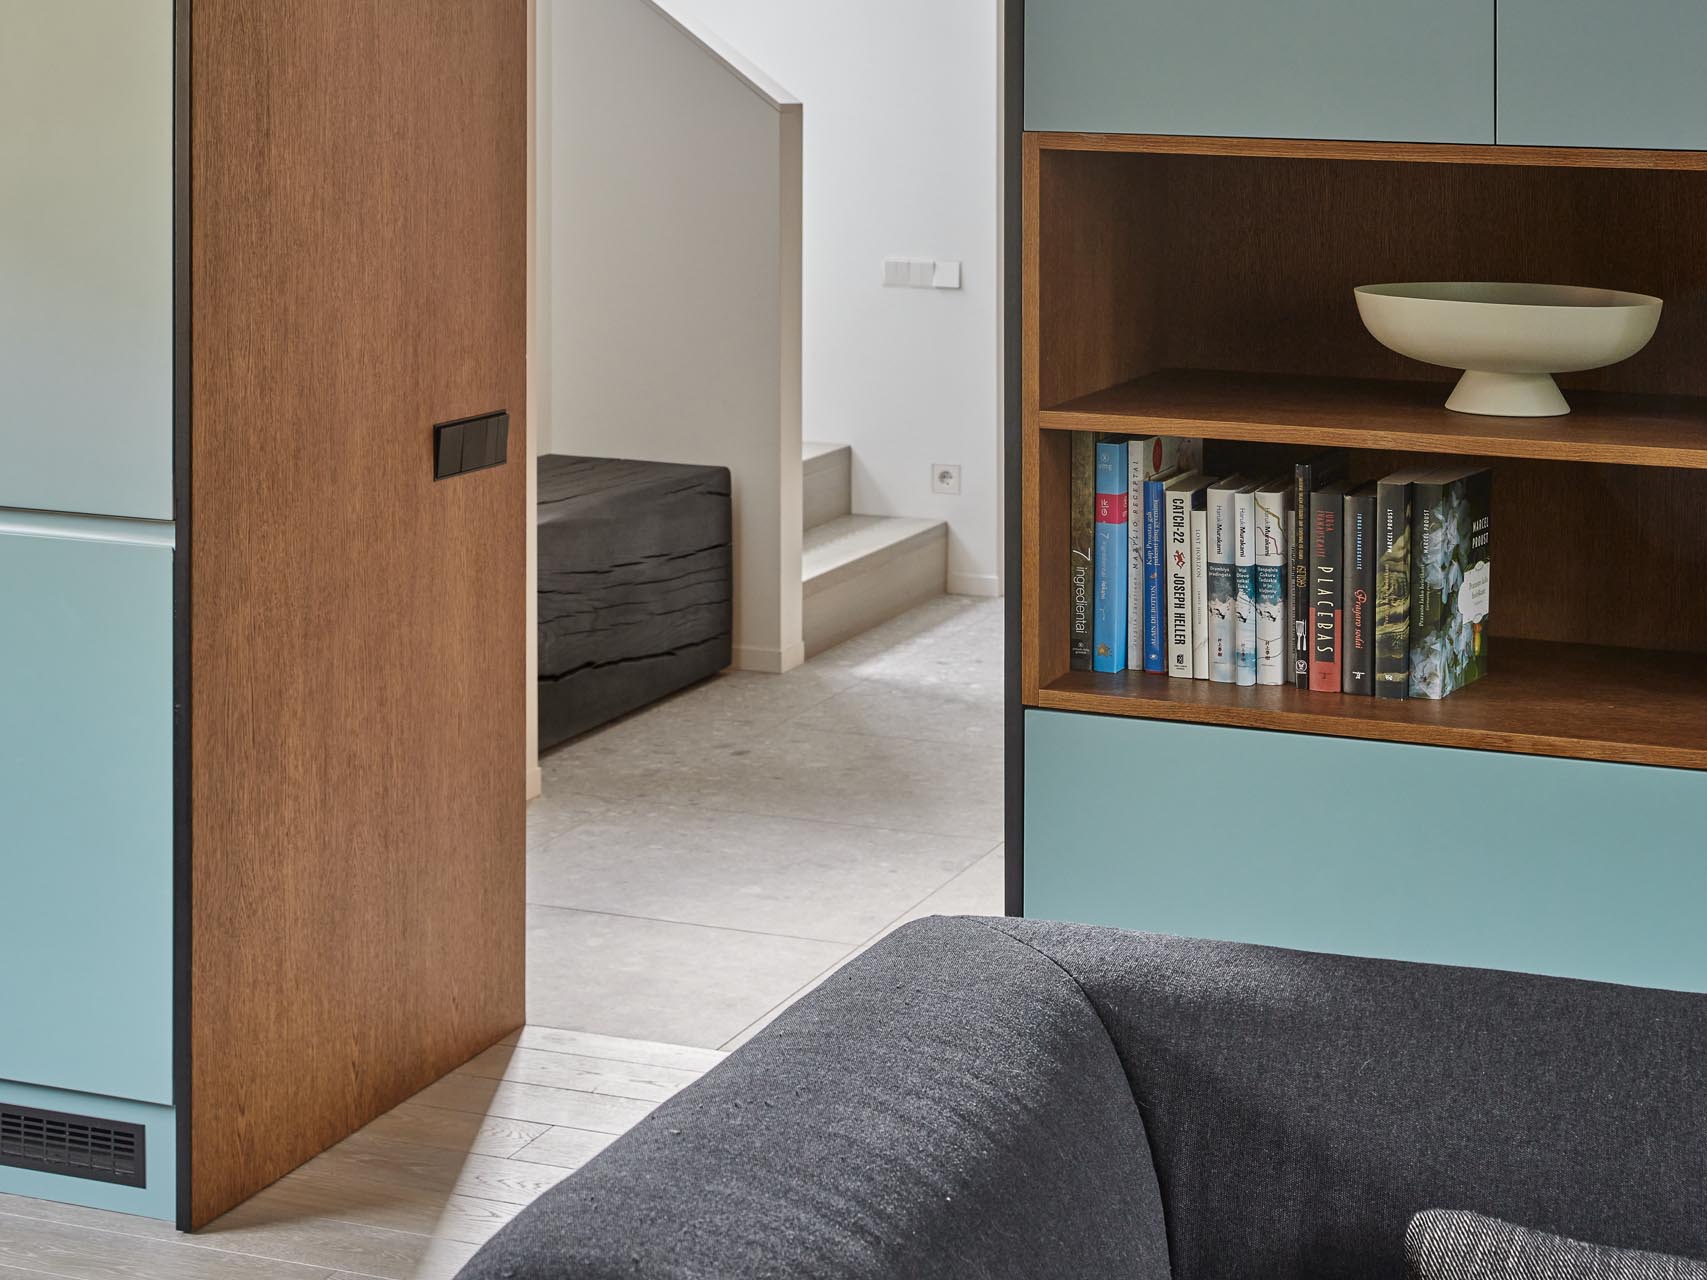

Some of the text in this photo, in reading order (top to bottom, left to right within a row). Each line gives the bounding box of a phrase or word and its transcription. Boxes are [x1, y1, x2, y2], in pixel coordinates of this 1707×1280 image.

[1172, 498, 1186, 544] CATCH-22
[1072, 547, 1091, 562] 7
[1073, 566, 1088, 635] ingredientai
[1150, 614, 1157, 624] DE
[1173, 573, 1187, 646] JOSEPH HELLER
[1317, 566, 1334, 653] PLACEBAS
[1352, 589, 1367, 649] Pragaro sodai
[1150, 625, 1158, 646] ALAIN
